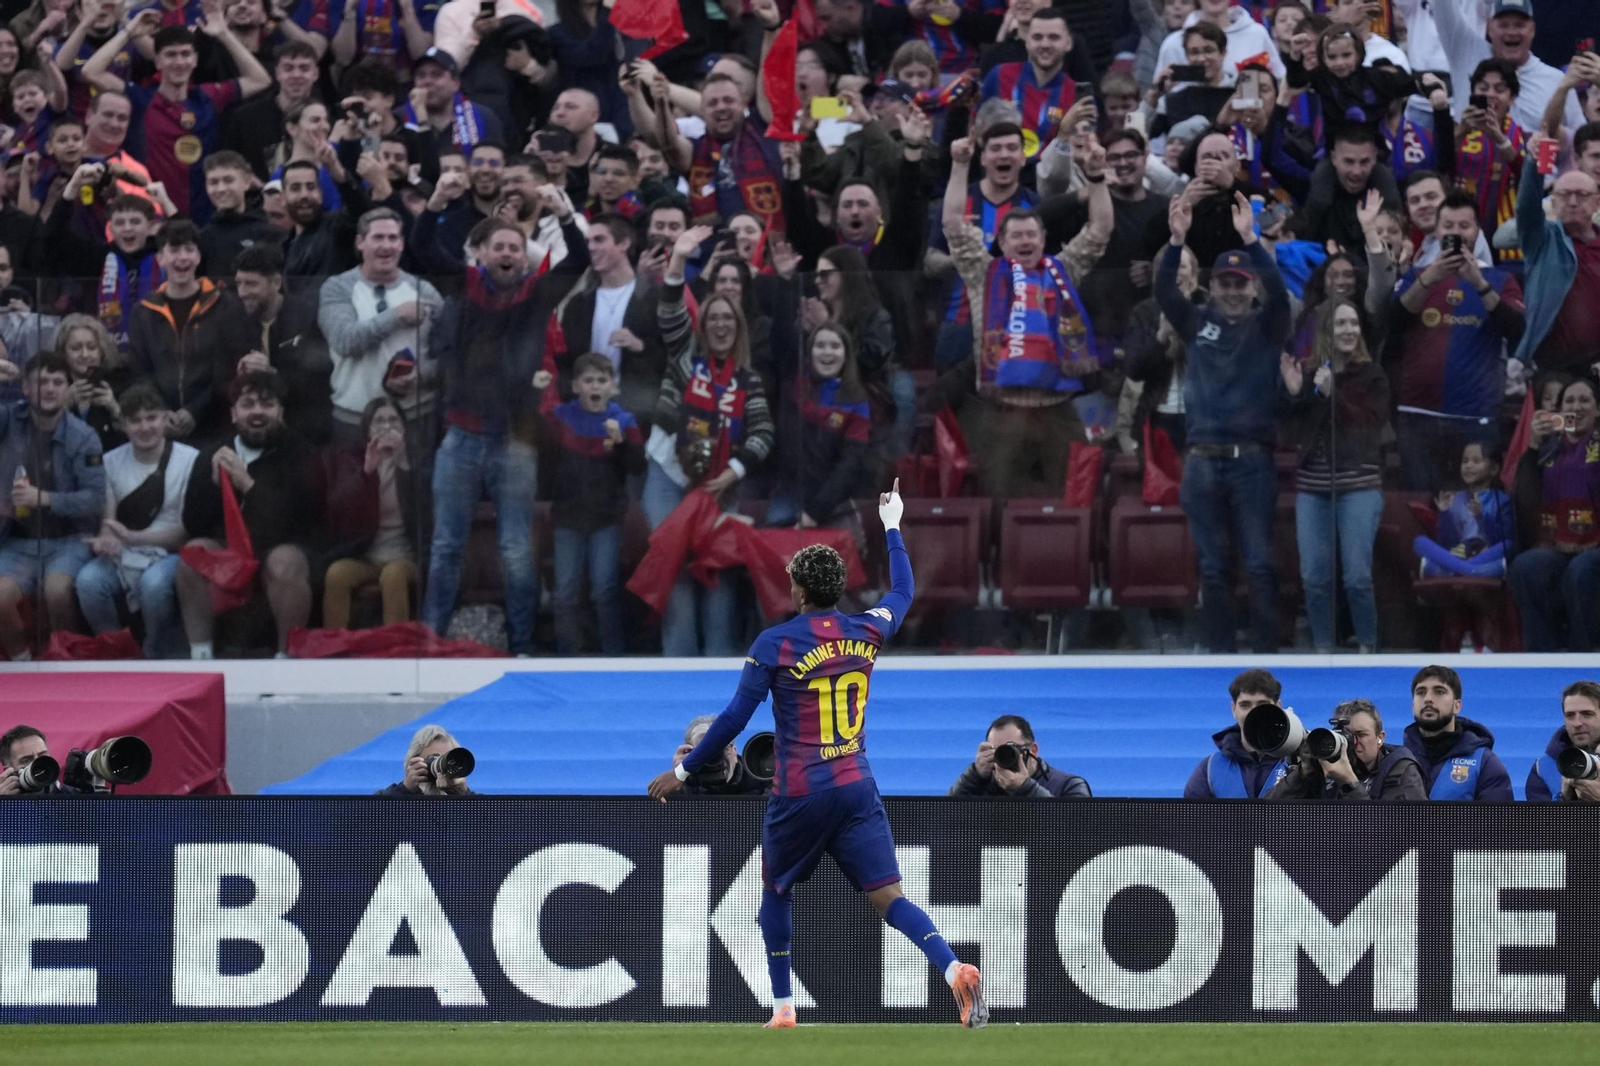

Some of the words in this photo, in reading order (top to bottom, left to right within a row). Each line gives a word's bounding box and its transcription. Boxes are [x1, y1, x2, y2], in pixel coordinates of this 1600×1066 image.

[1443, 313, 1482, 327] Spotify
[788, 642, 836, 680] LAMINE
[836, 640, 878, 663] YAMAL
[807, 671, 868, 744] 10
[172, 841, 818, 1009] BACK
[879, 845, 1600, 1012] HOME
